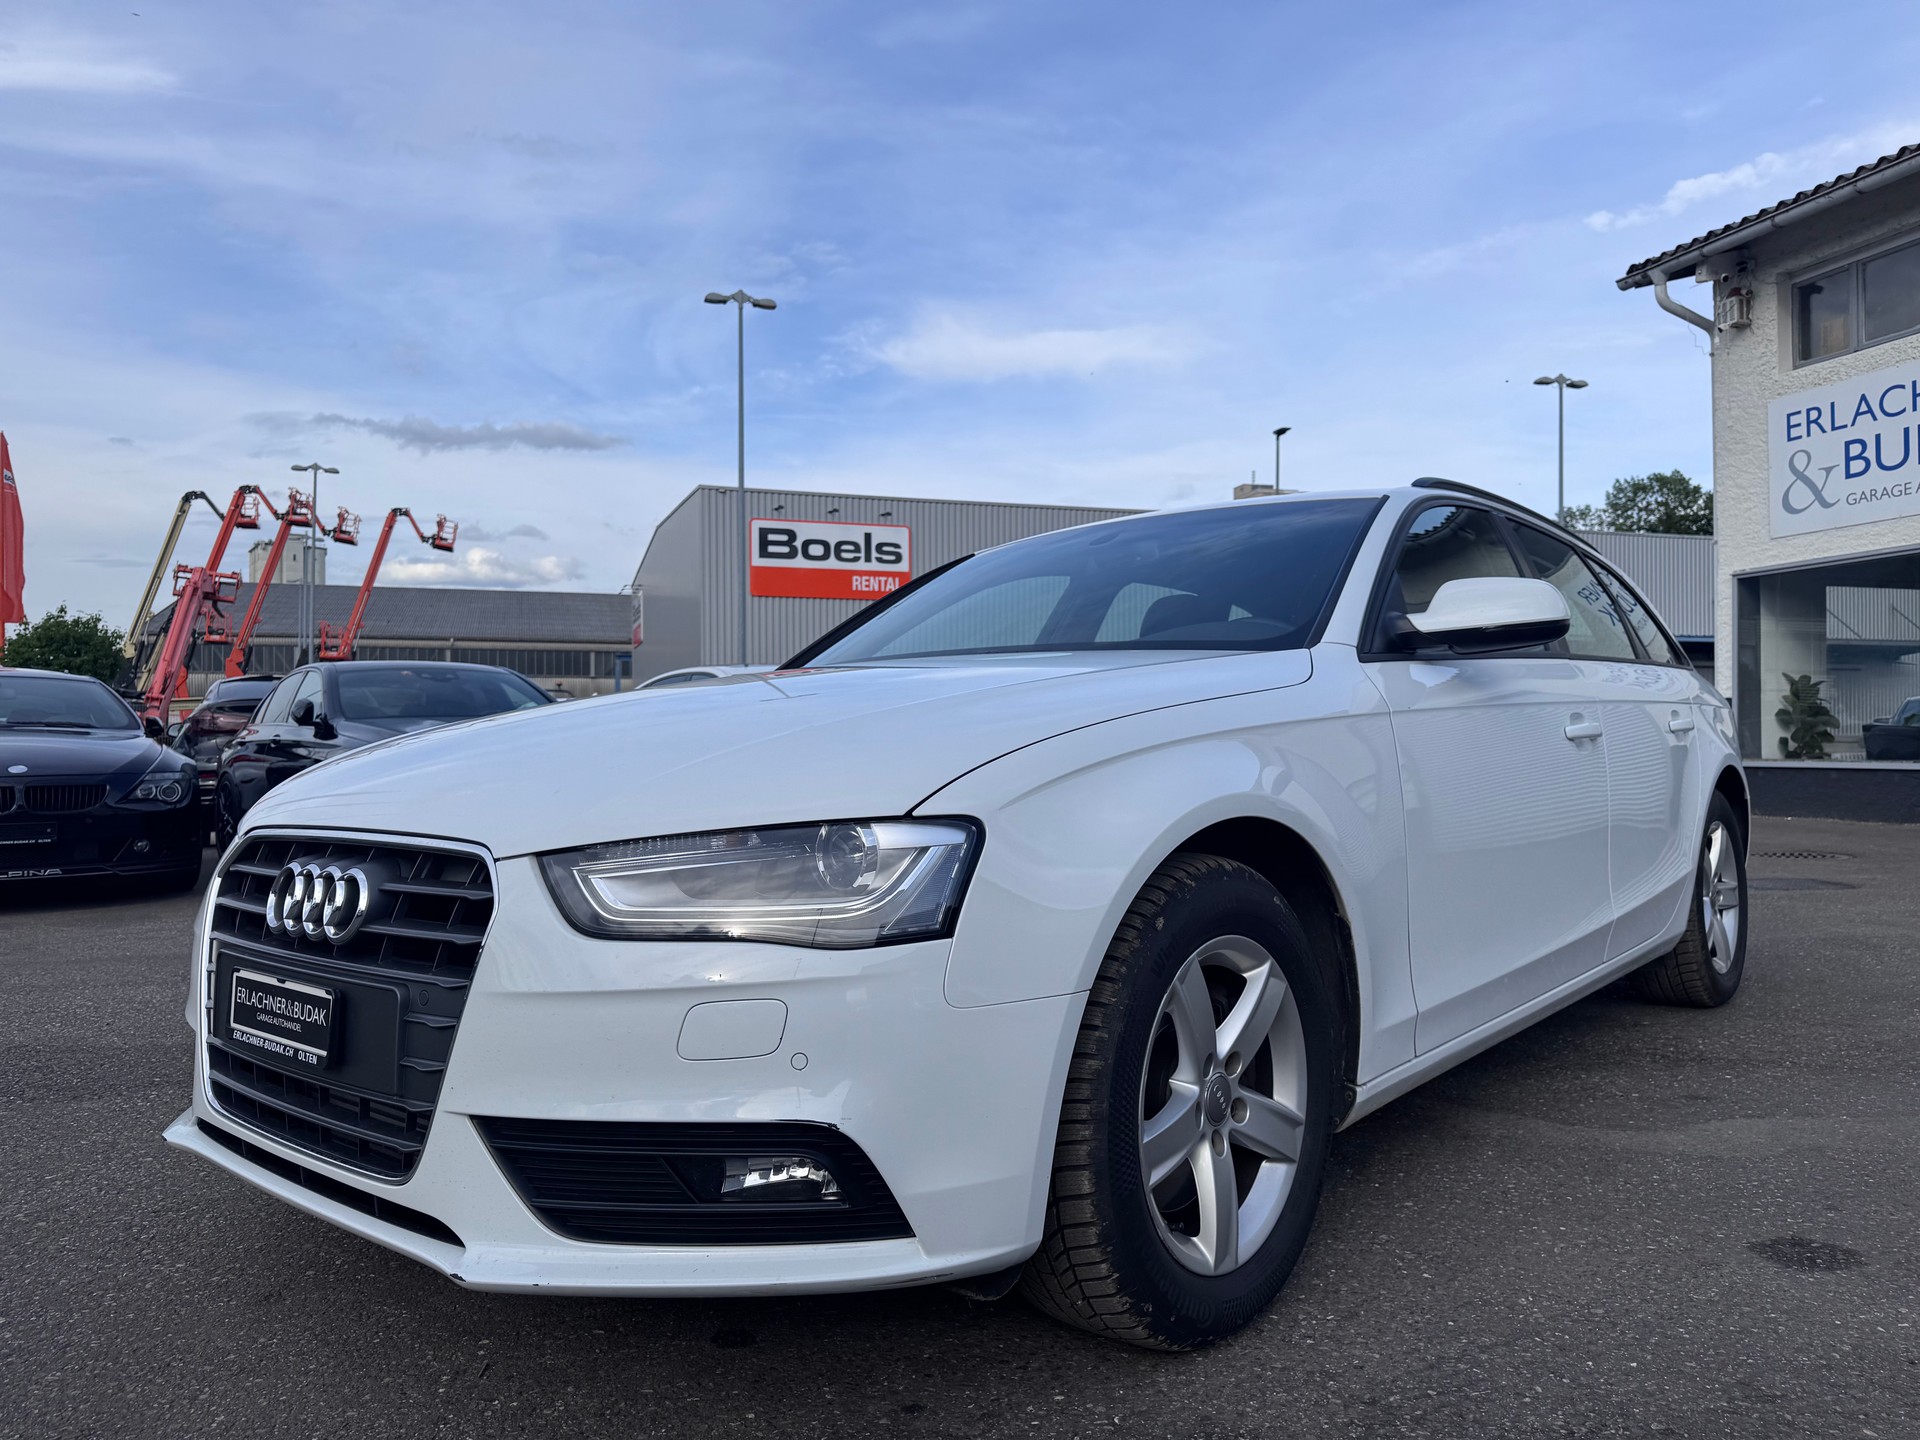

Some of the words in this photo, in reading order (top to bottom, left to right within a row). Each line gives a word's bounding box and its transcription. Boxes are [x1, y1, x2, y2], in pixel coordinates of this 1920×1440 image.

[1782, 449, 1840, 515] &
[1844, 424, 1920, 480] BU
[1846, 482, 1912, 506] GARAGE
[759, 527, 903, 564] Boels
[236, 986, 327, 1026] ERLACHNER&BUDAK
[233, 1030, 294, 1057] ERLACHNER-BUDAK.CH
[298, 1050, 318, 1065] OLTEN
